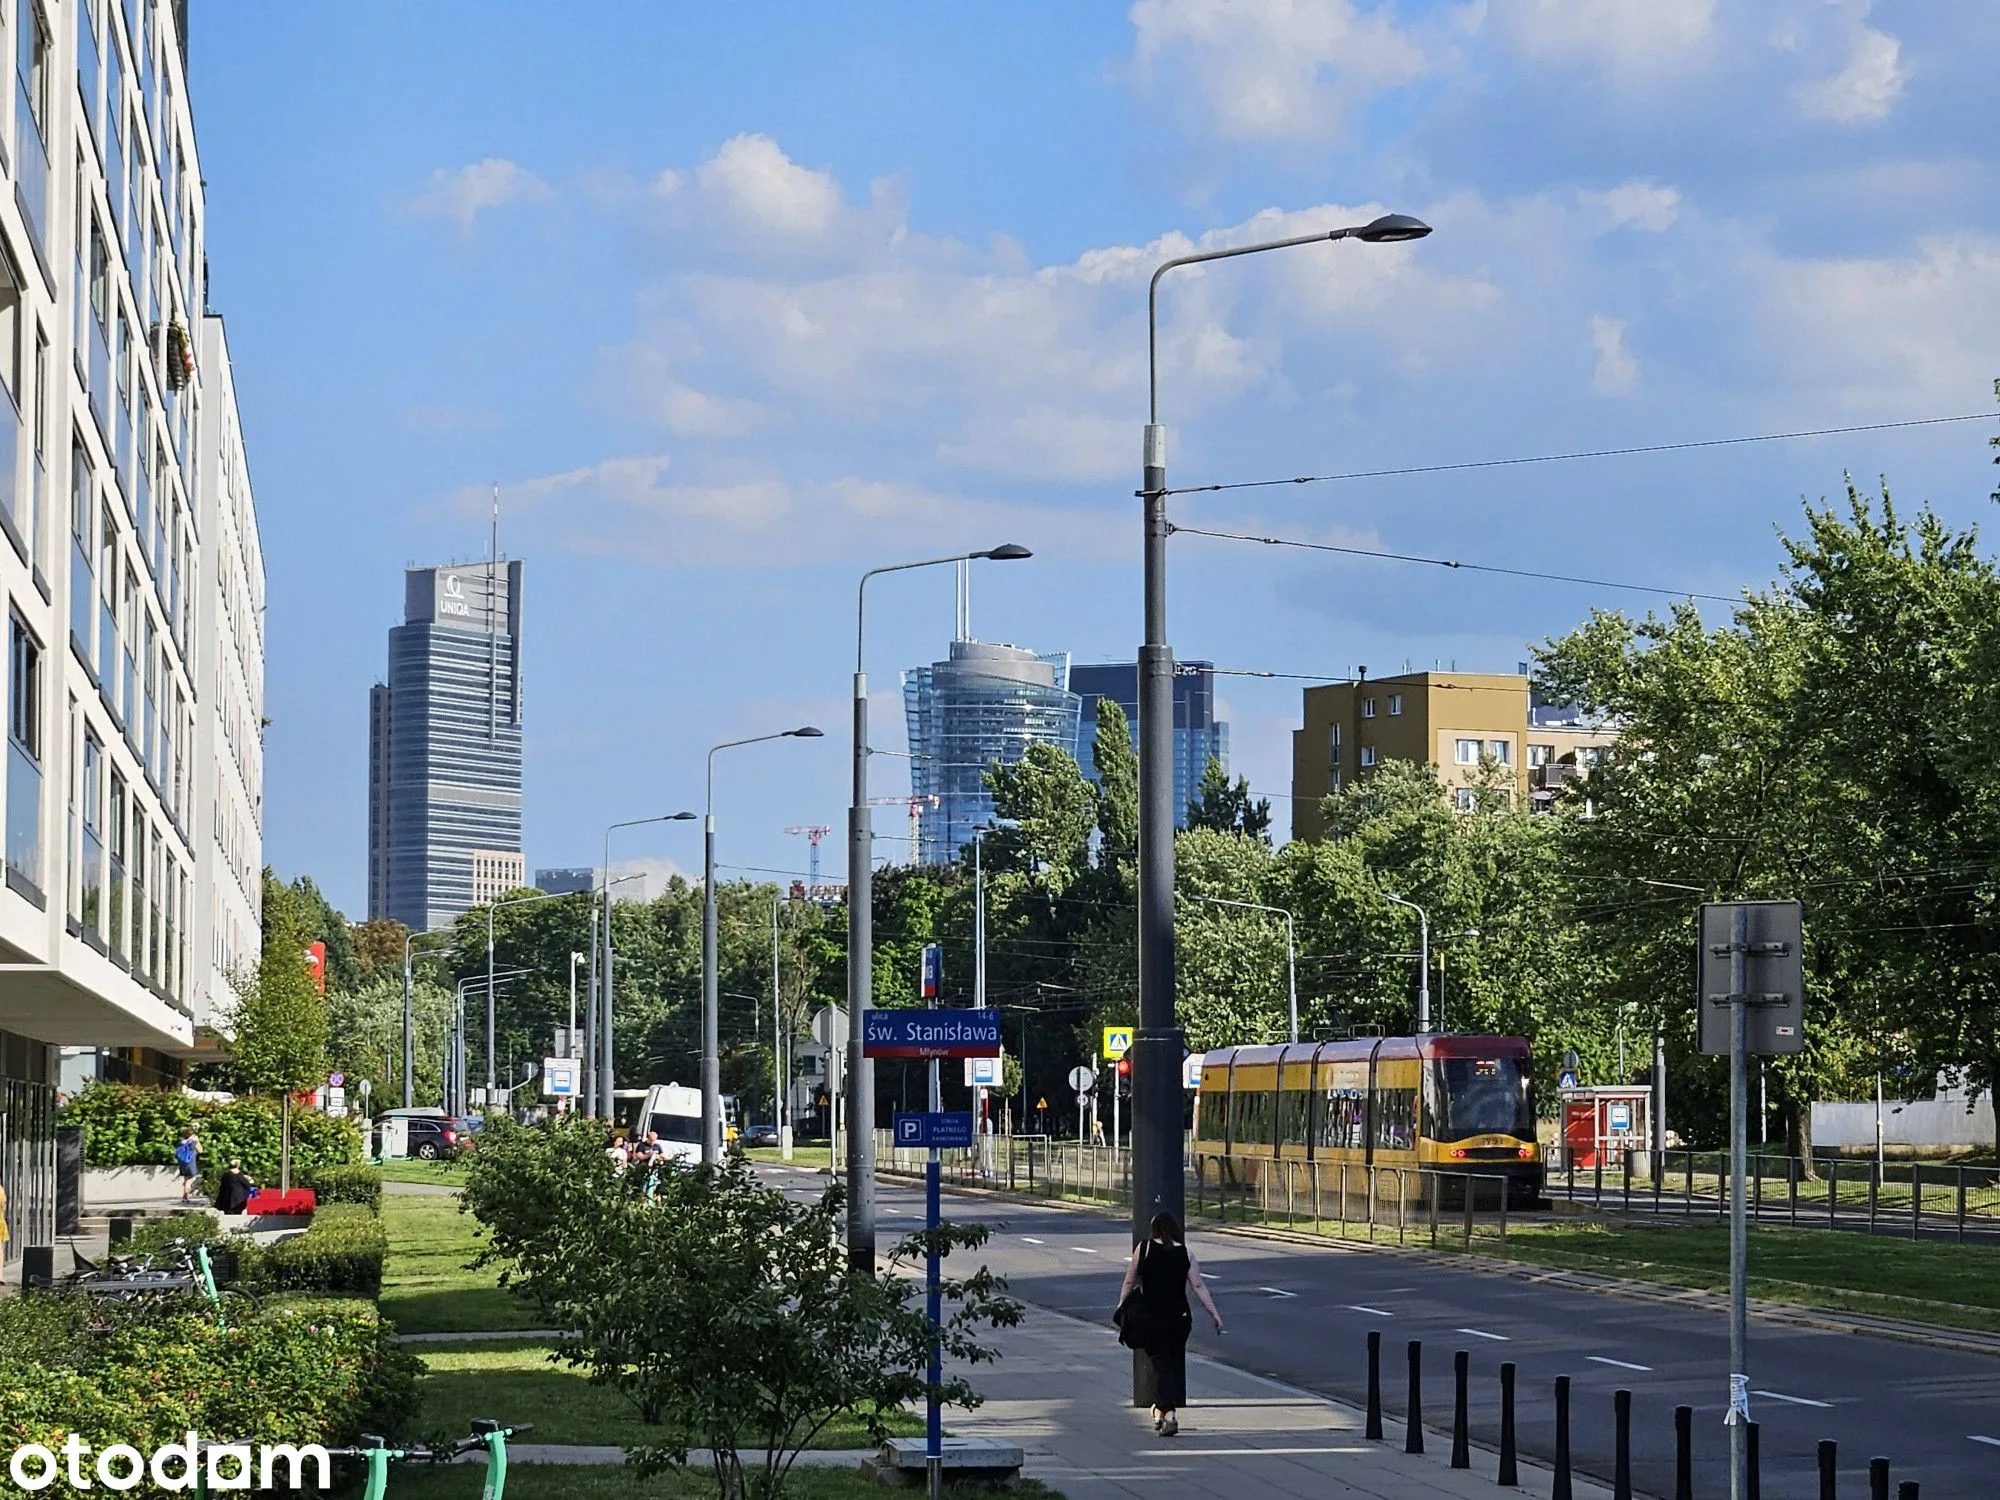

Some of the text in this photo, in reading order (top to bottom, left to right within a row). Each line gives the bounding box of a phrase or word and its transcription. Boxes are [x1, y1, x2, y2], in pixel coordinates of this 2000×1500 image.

[441, 600, 471, 617] UNIQA
[871, 1012, 888, 1021] ulica
[977, 1011, 994, 1021] 14-6
[868, 1021, 997, 1041] św. Stanisława
[919, 1047, 950, 1058] Młynów
[904, 1122, 917, 1139] P
